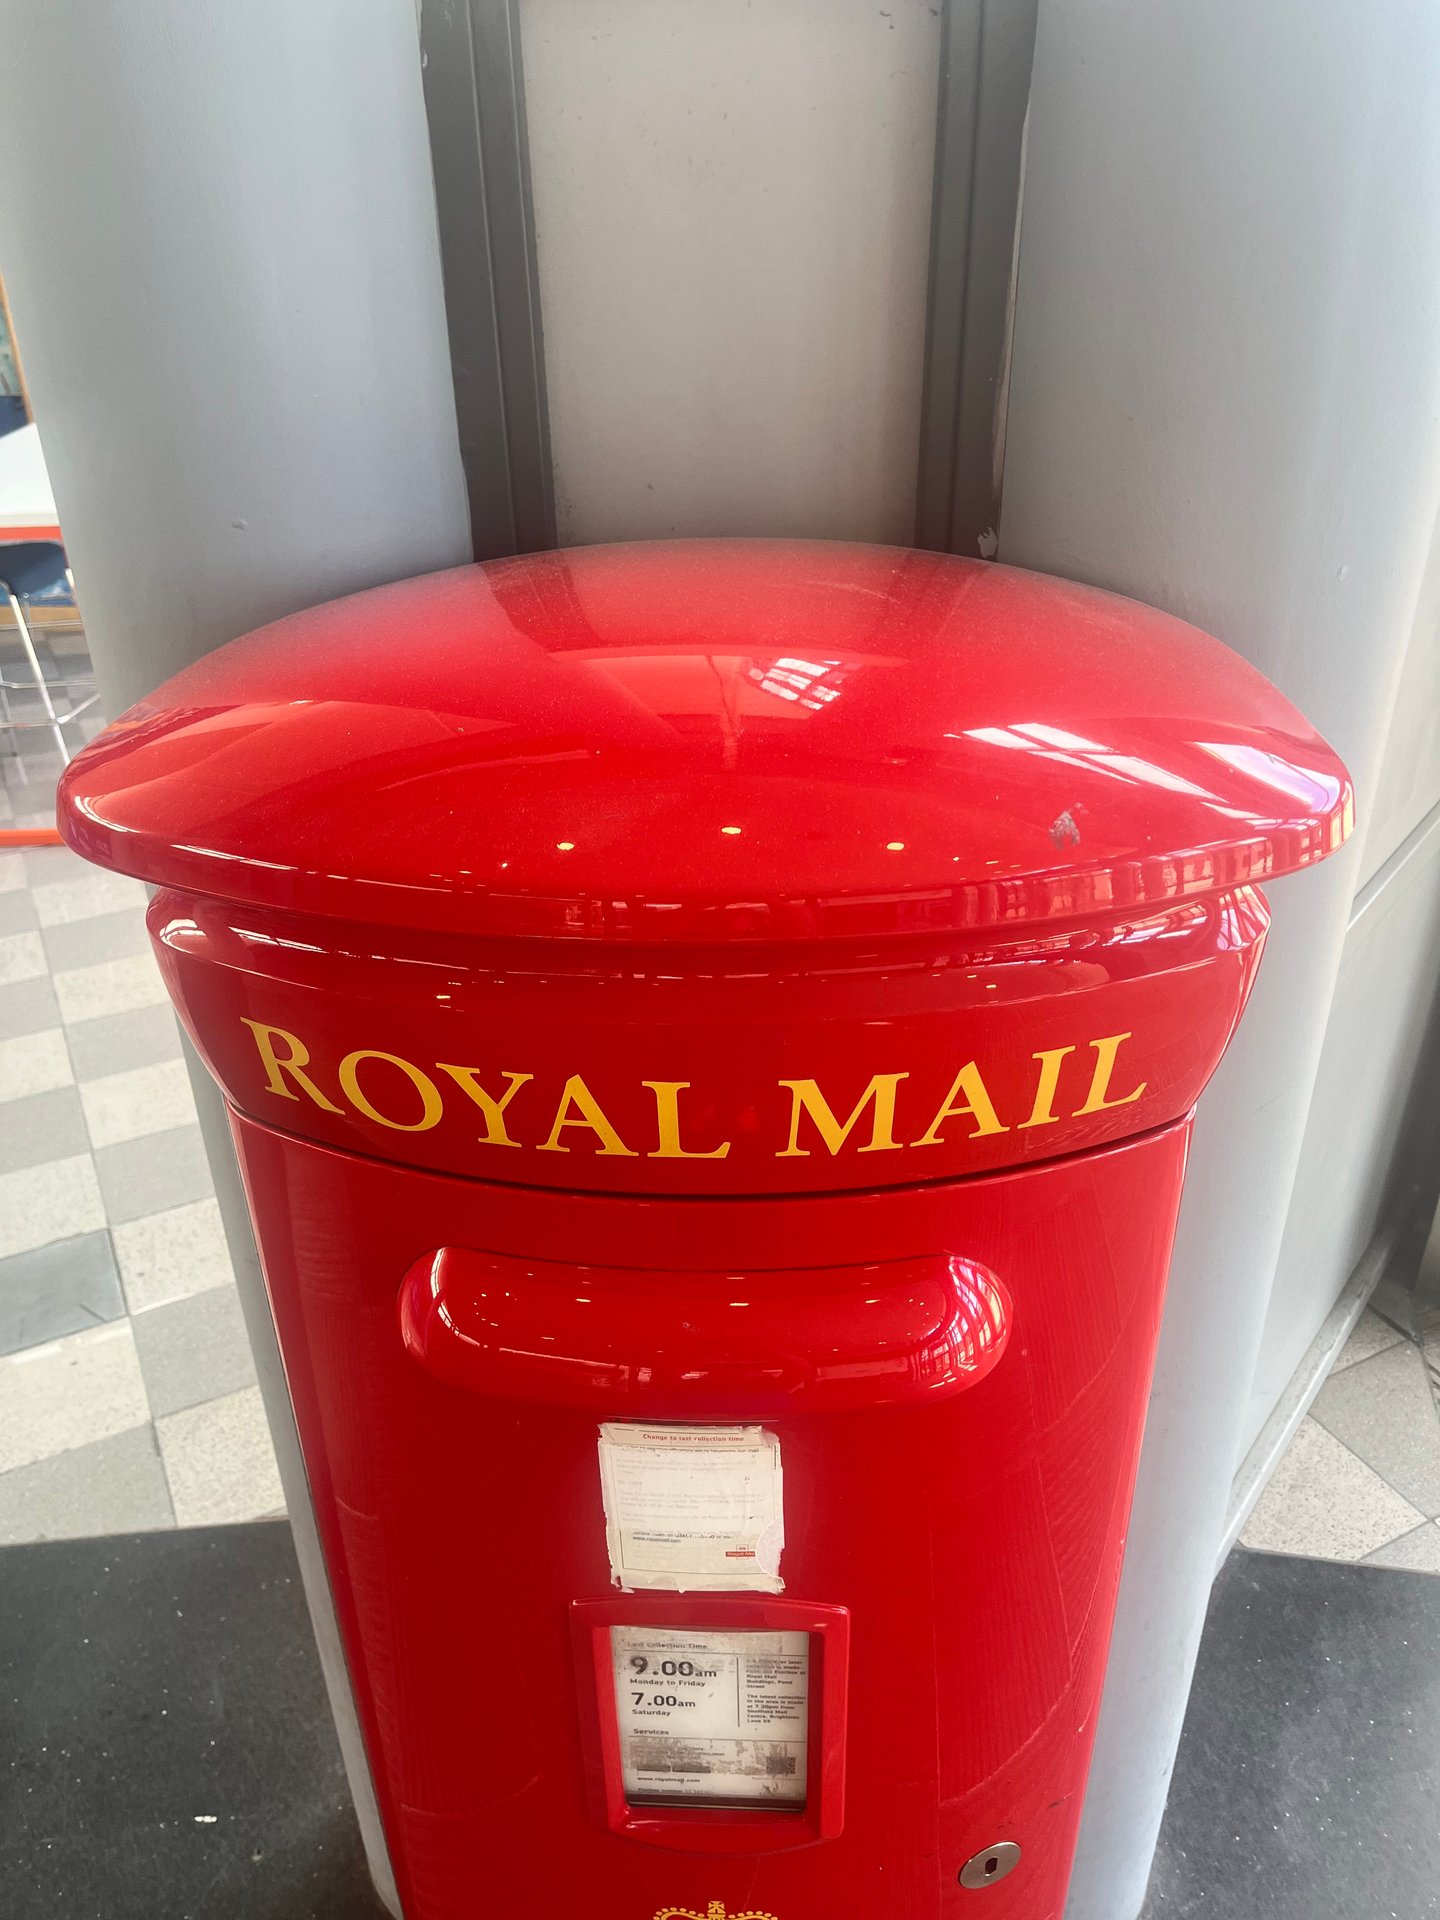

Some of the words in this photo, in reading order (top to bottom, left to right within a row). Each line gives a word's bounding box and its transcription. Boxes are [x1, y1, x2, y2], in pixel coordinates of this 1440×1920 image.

[240, 1016, 731, 1159] ROYAL
[775, 1031, 1149, 1157] MAIL
[643, 1433, 668, 1442] Change
[630, 1656, 717, 1677] 9.00am
[630, 1678, 664, 1686] Monday
[678, 1679, 705, 1687] Friday
[631, 1692, 696, 1707] 7.00am
